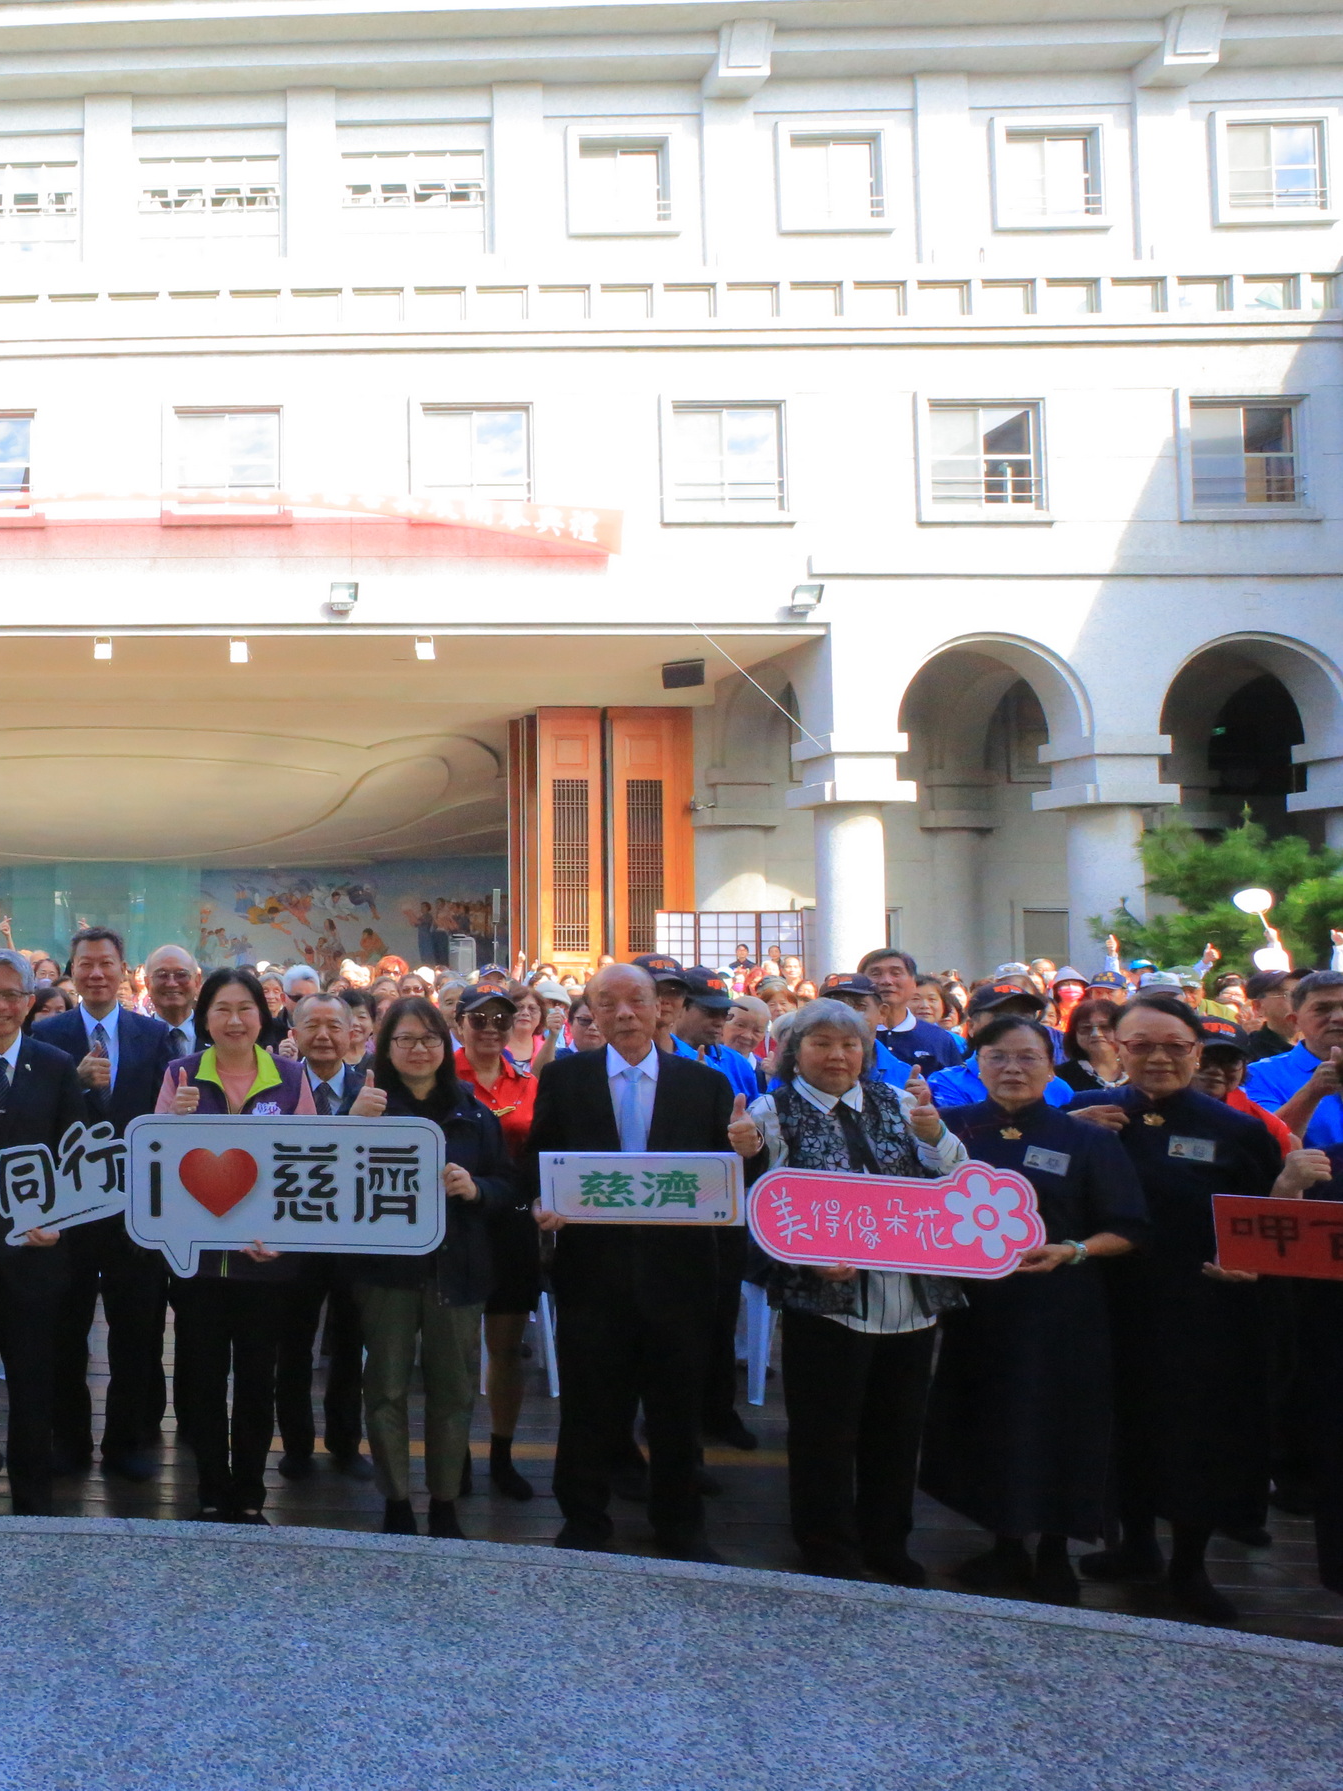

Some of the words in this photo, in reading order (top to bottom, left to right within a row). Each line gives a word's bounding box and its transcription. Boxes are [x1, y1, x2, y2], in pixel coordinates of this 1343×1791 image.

[148, 1141, 162, 1218] i
[272, 1142, 421, 1224] 慈濟
[769, 1186, 953, 1251] 美得像朵花
